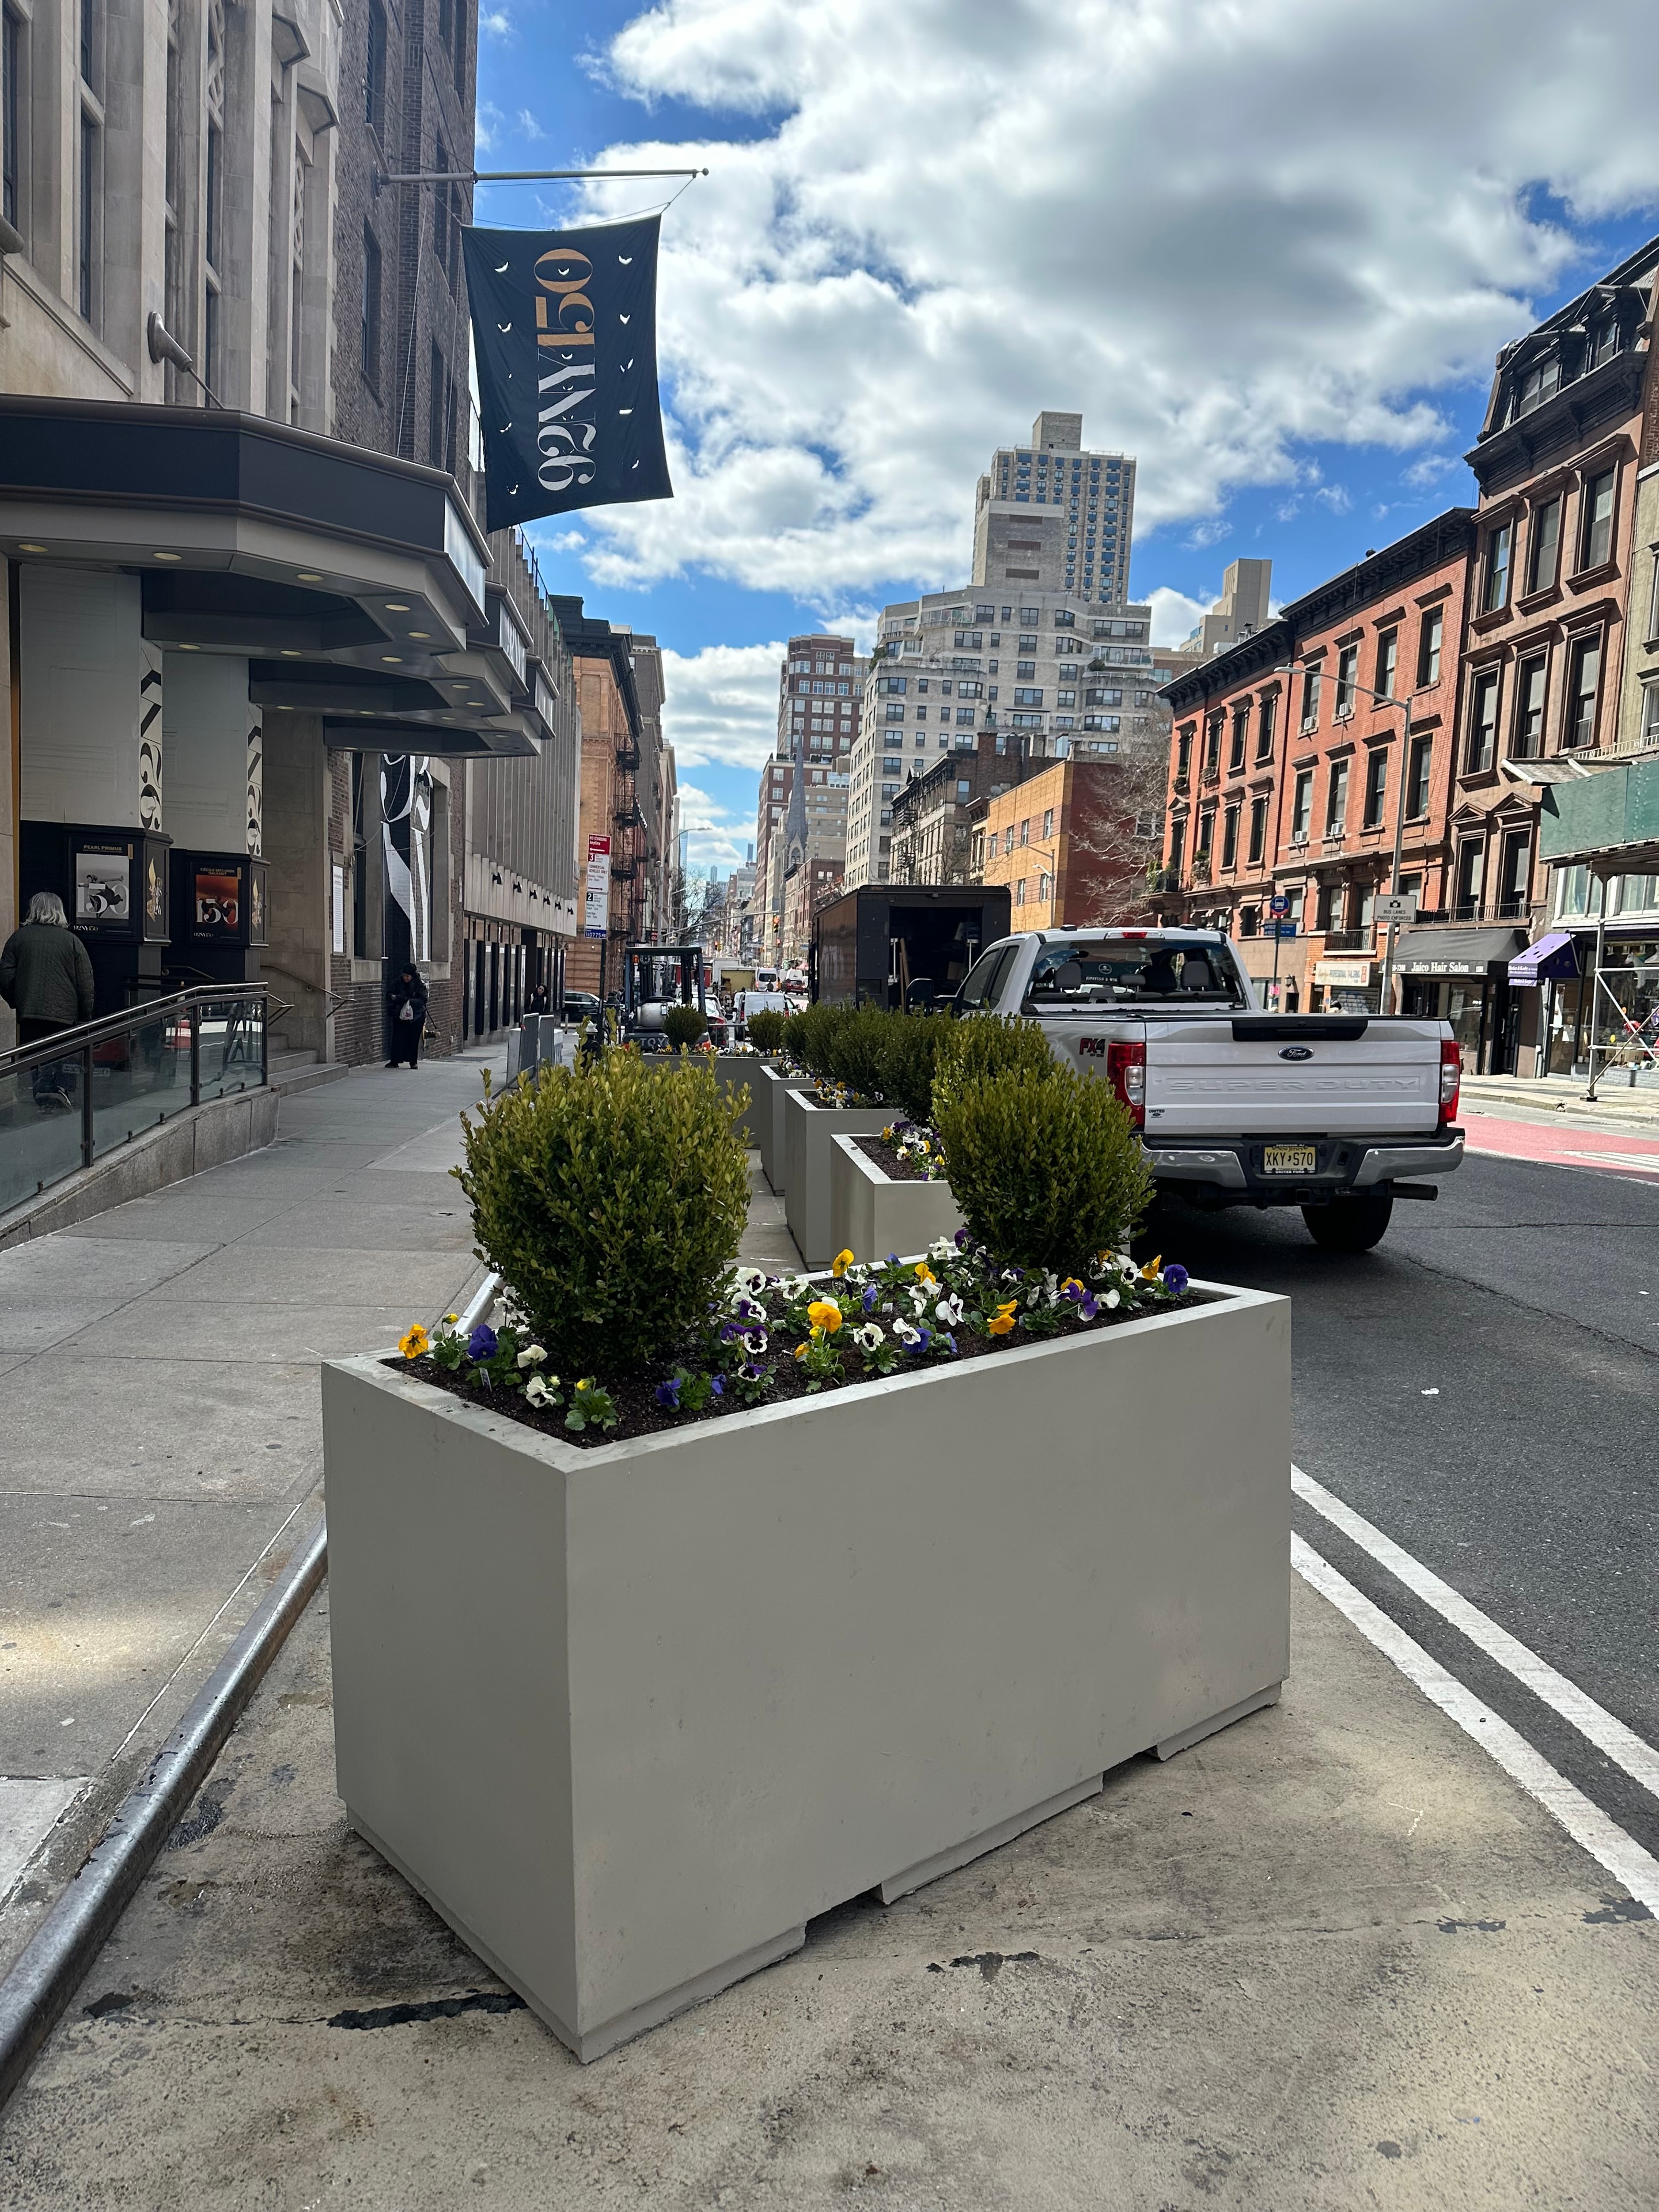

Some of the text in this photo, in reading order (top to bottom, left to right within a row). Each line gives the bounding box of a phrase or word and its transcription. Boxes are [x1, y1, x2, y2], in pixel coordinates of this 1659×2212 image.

[1411, 962, 1429, 972] Jaico
[1431, 962, 1447, 972] Hair
[1449, 962, 1469, 973] Salon
[1079, 1038, 1106, 1055] FX4
[1287, 1049, 1307, 1057] Ford
[1171, 1079, 1416, 1091] SUPER DUTY
[1266, 1152, 1313, 1166] XKY S70
